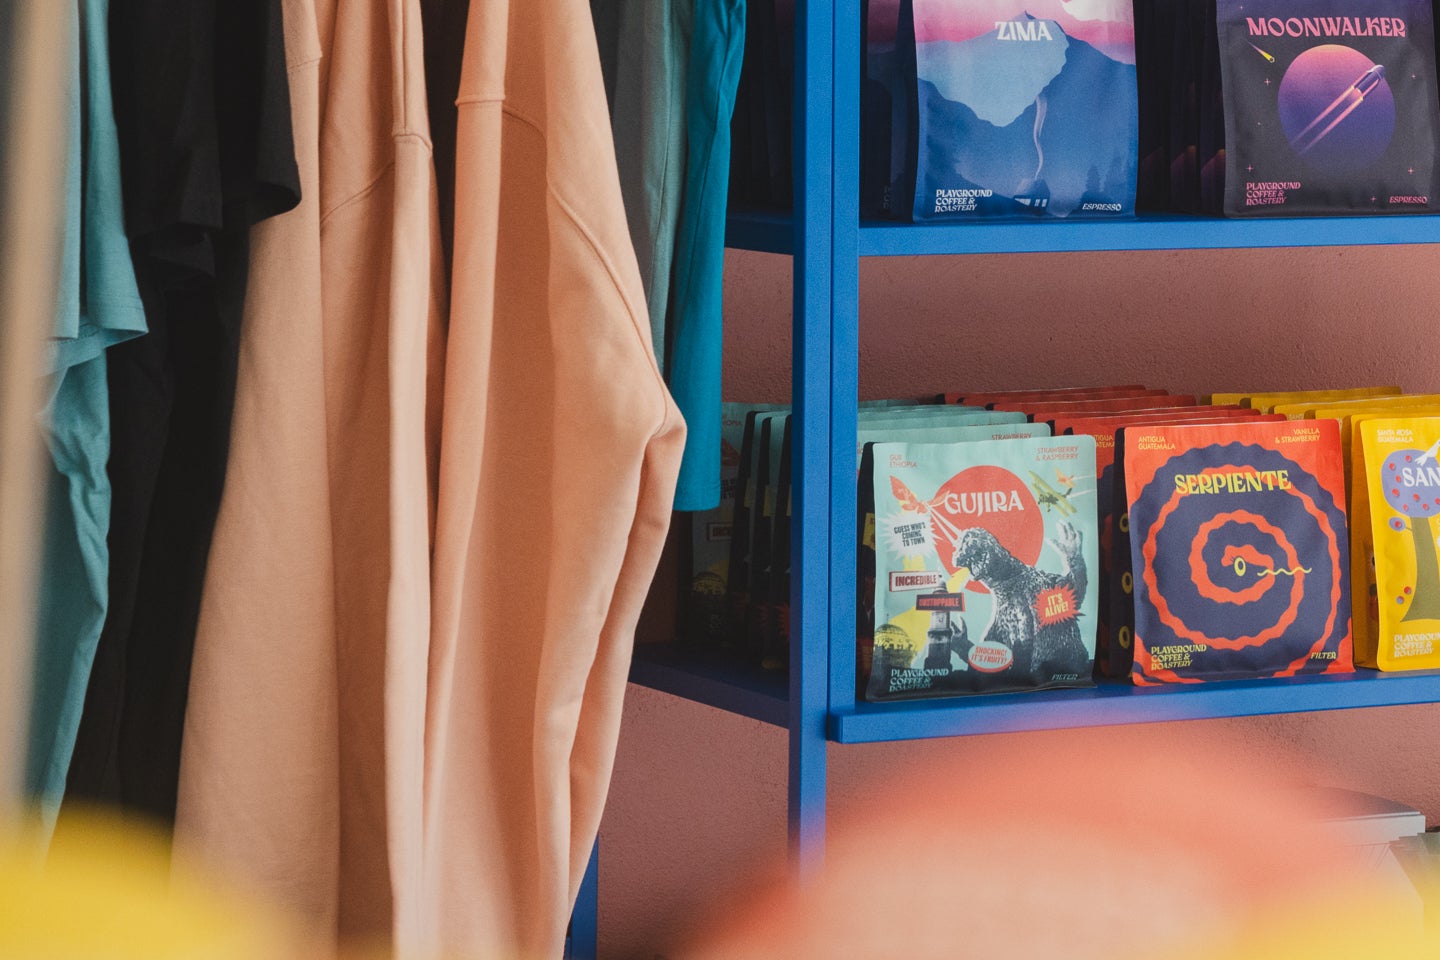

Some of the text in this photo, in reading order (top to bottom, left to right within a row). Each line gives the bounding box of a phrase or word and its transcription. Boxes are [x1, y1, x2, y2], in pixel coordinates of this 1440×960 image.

[995, 21, 1052, 41] ZIMA
[1246, 16, 1406, 38] MOONWALKER
[1246, 182, 1301, 190] PLAYGROUND
[1246, 190, 1276, 198] COFFEE
[936, 197, 968, 205] COFFEE
[1246, 197, 1286, 206] ROASTERY
[1389, 196, 1427, 204] ESPRESSO
[935, 204, 977, 213] ROASTERY
[1082, 203, 1121, 211] ESPRESSO
[1281, 434, 1320, 443] STRAWBERRY
[1174, 470, 1291, 495] SERPIENTE
[944, 490, 1024, 517] GUJIRA
[895, 574, 937, 586] INCREDIBLE
[1048, 593, 1063, 605] IT'S
[1045, 603, 1069, 618] ALIVE!
[1151, 644, 1206, 655] PLAYGROUND
[1151, 654, 1182, 663] COFFEE
[1151, 660, 1193, 671] ROASTERY
[891, 668, 949, 677] PLAYGROUND
